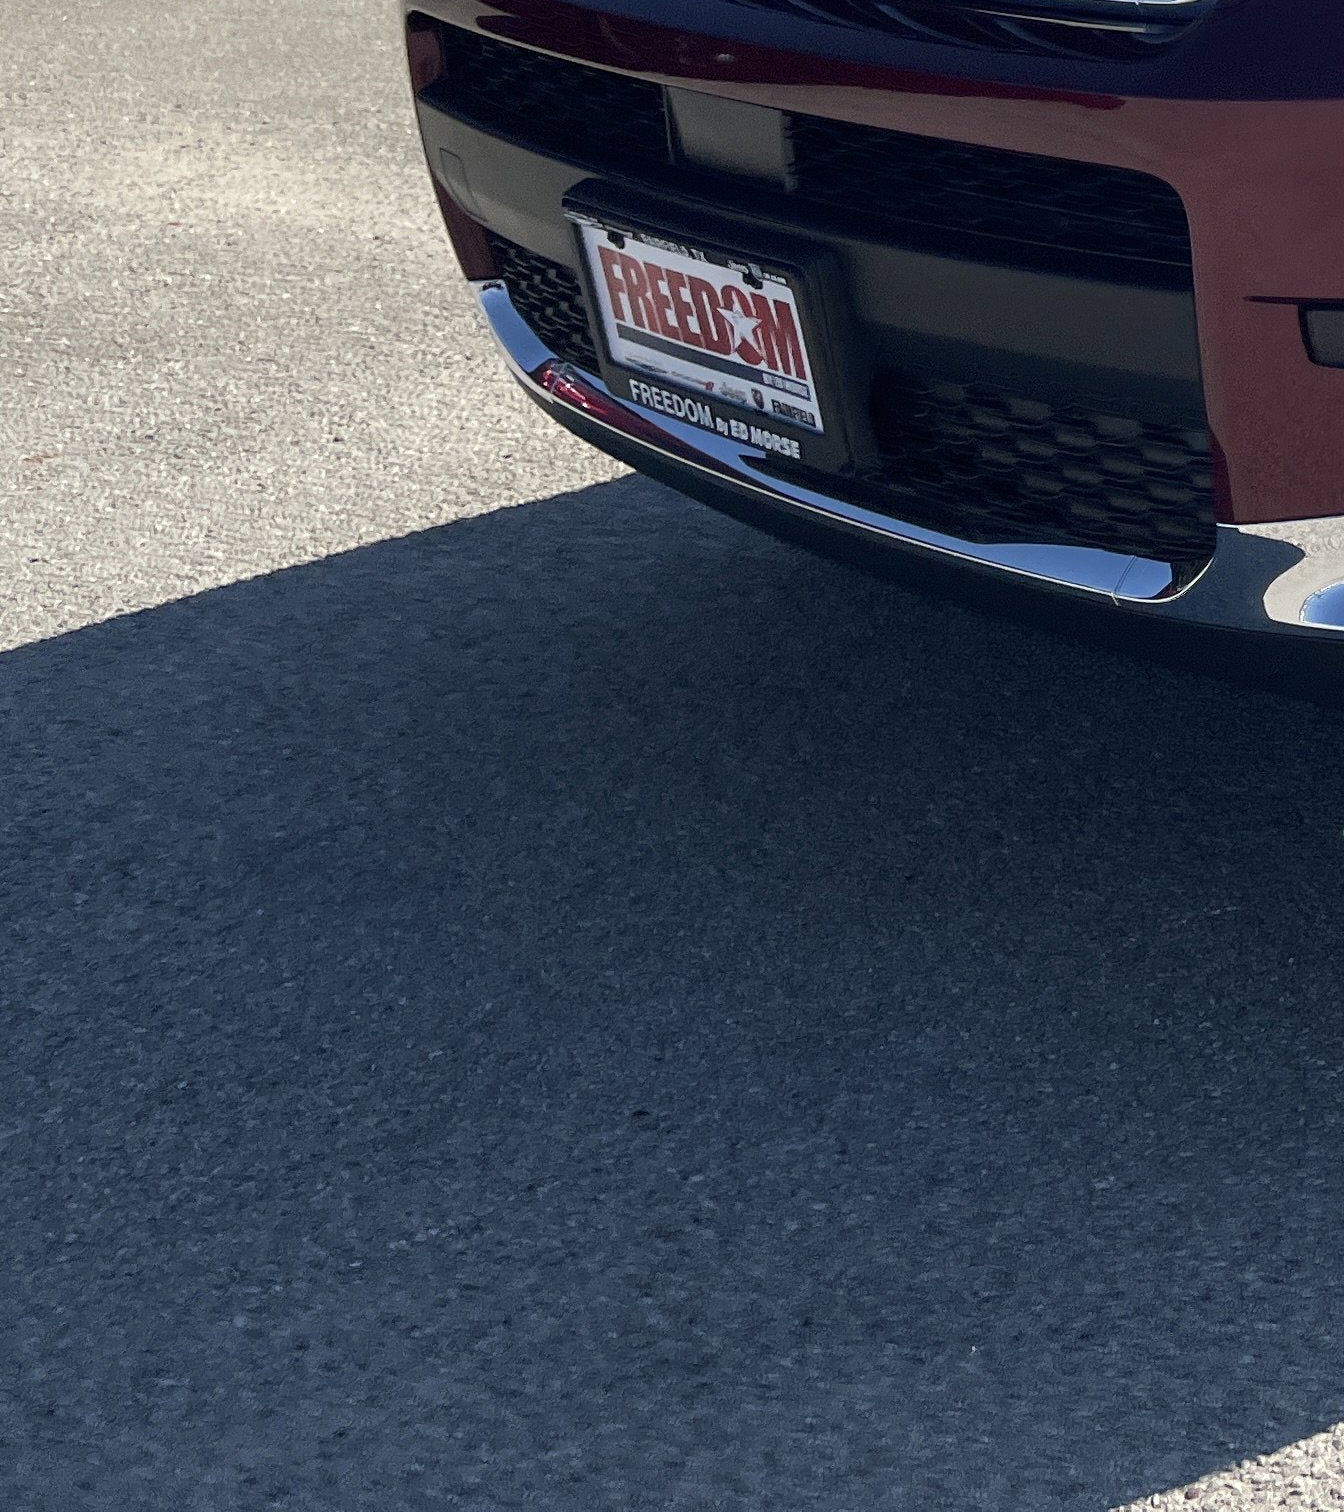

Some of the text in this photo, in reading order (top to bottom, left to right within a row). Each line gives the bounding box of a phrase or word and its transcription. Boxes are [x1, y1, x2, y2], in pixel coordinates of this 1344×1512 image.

[598, 244, 807, 380] FREEDOM
[628, 378, 715, 430] FREEDOM
[730, 418, 749, 441] ED
[751, 425, 801, 460] MORSE
